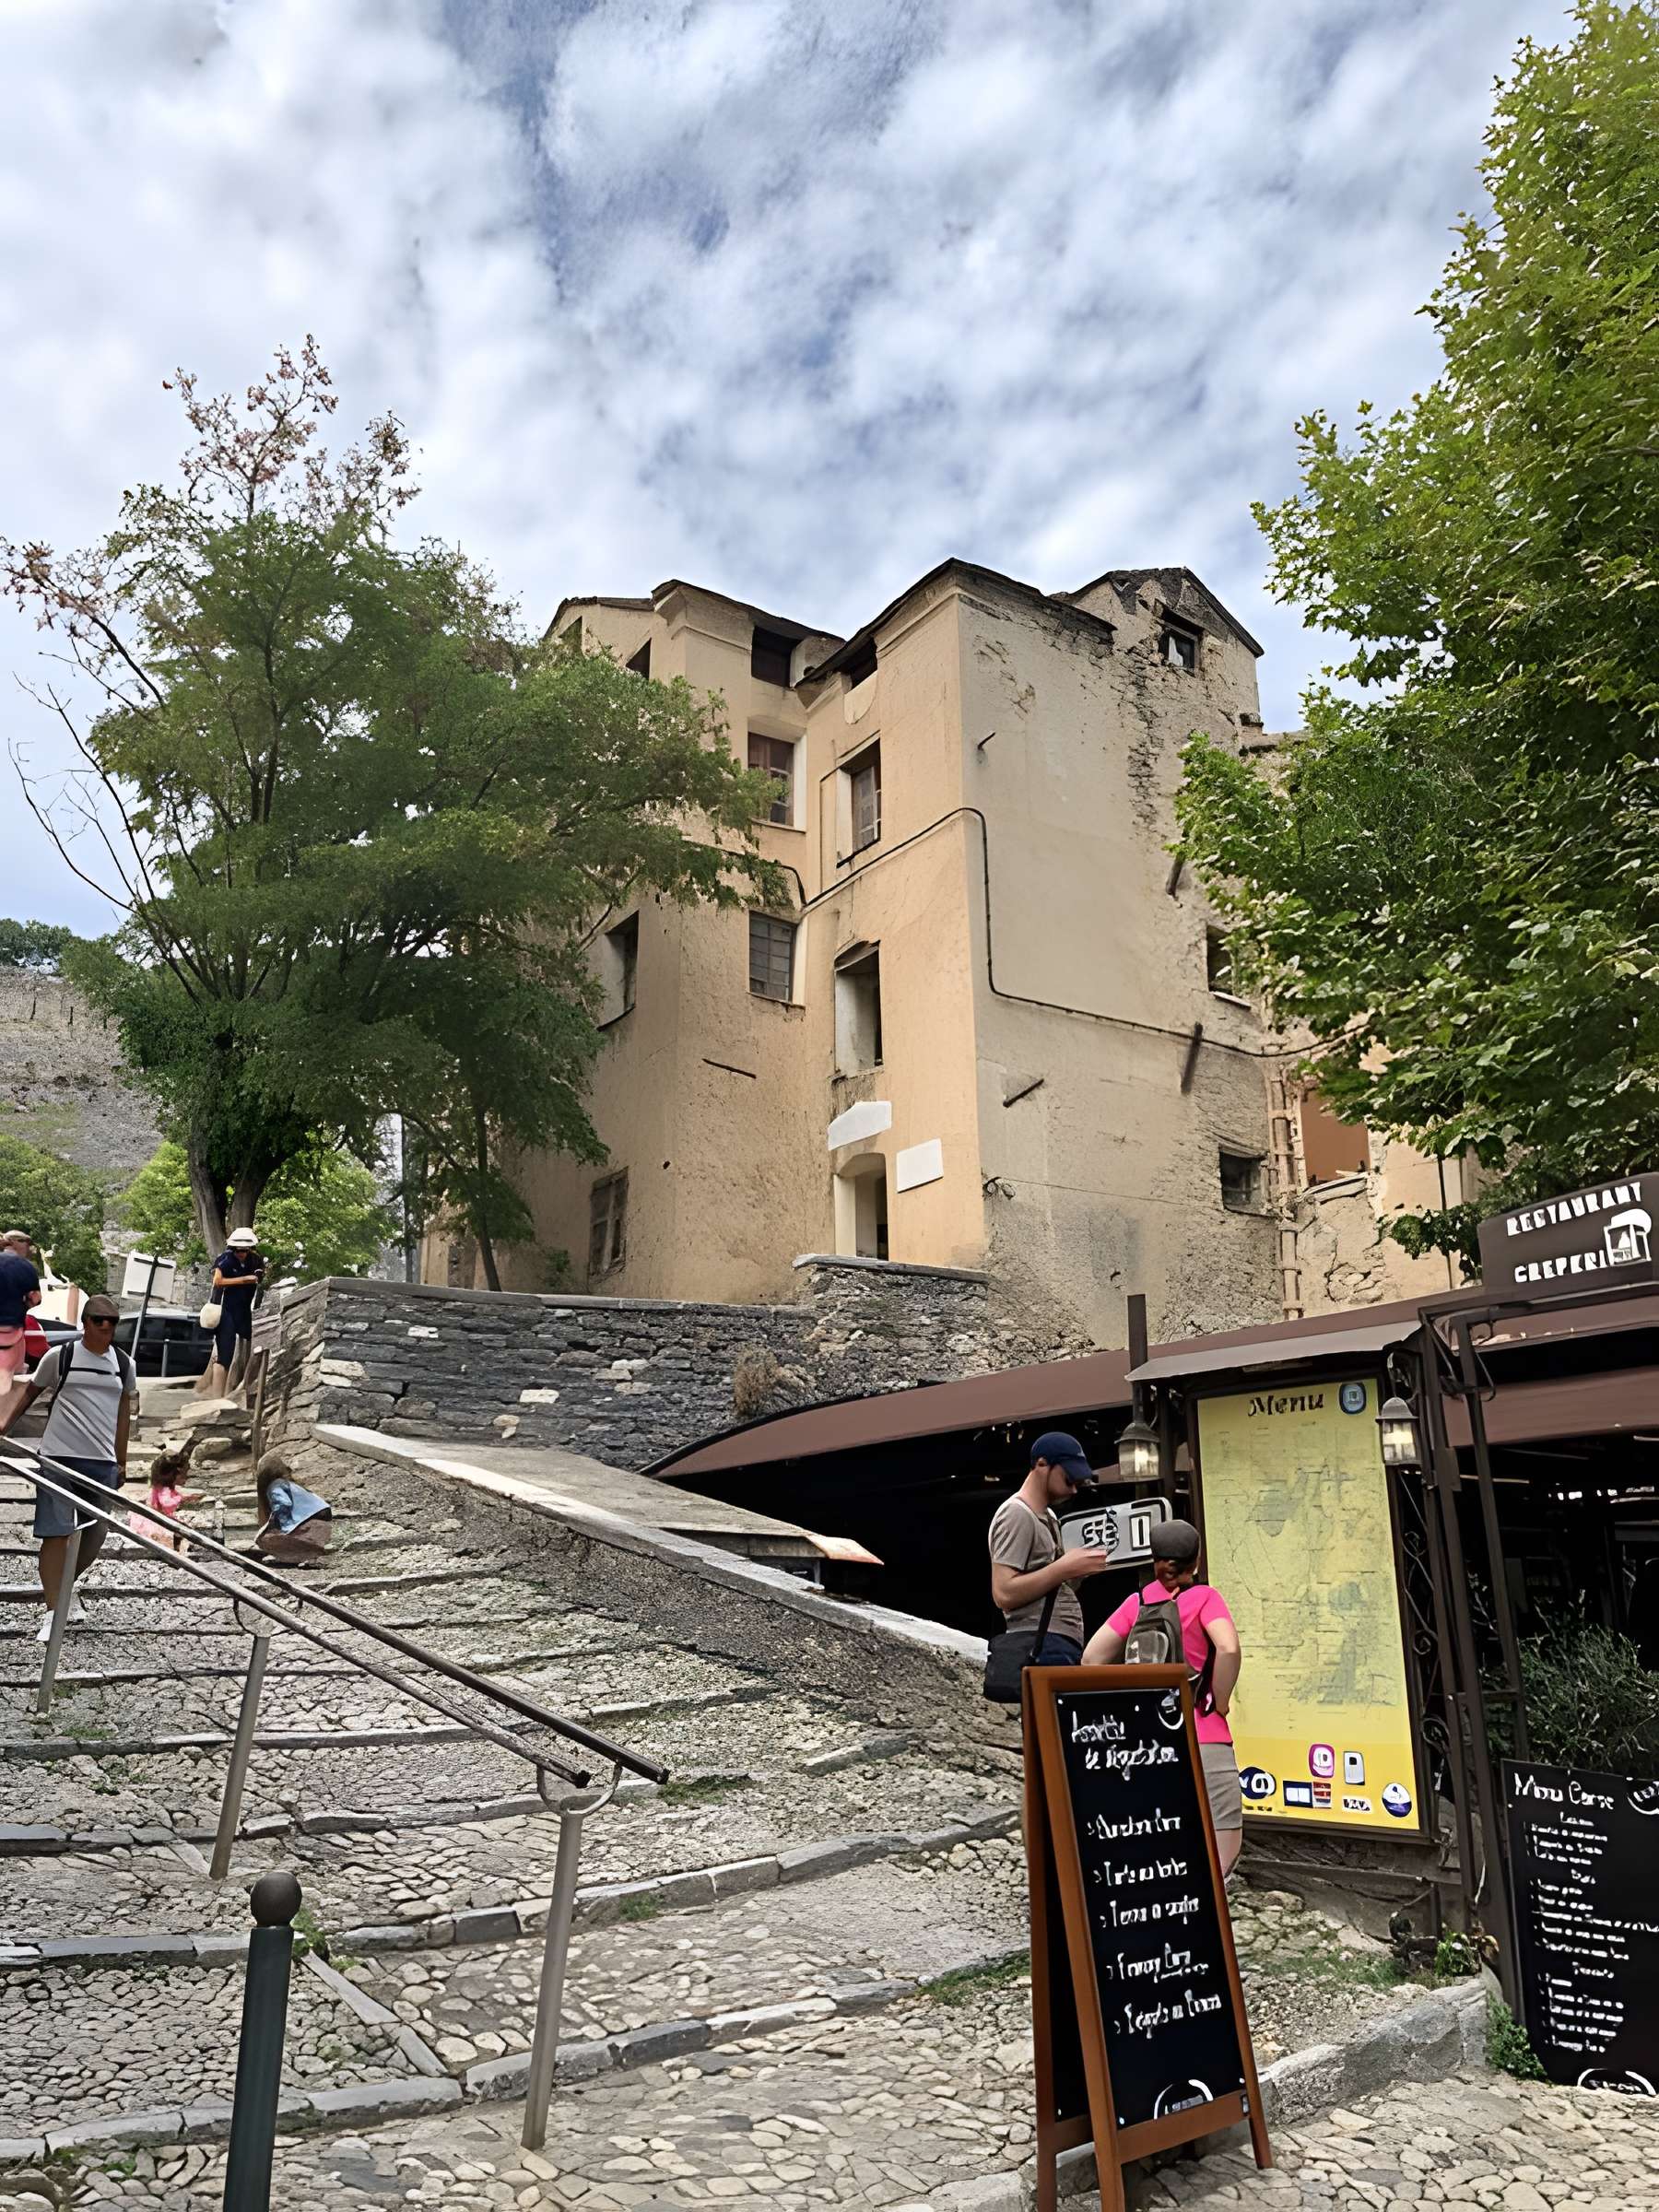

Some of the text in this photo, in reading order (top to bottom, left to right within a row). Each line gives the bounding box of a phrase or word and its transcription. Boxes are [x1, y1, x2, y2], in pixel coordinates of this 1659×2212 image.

[1506, 1182, 1641, 1236] RESTAURANT
[1513, 1248, 1618, 1283] CREPERI
[1247, 1393, 1324, 1418] Menu
